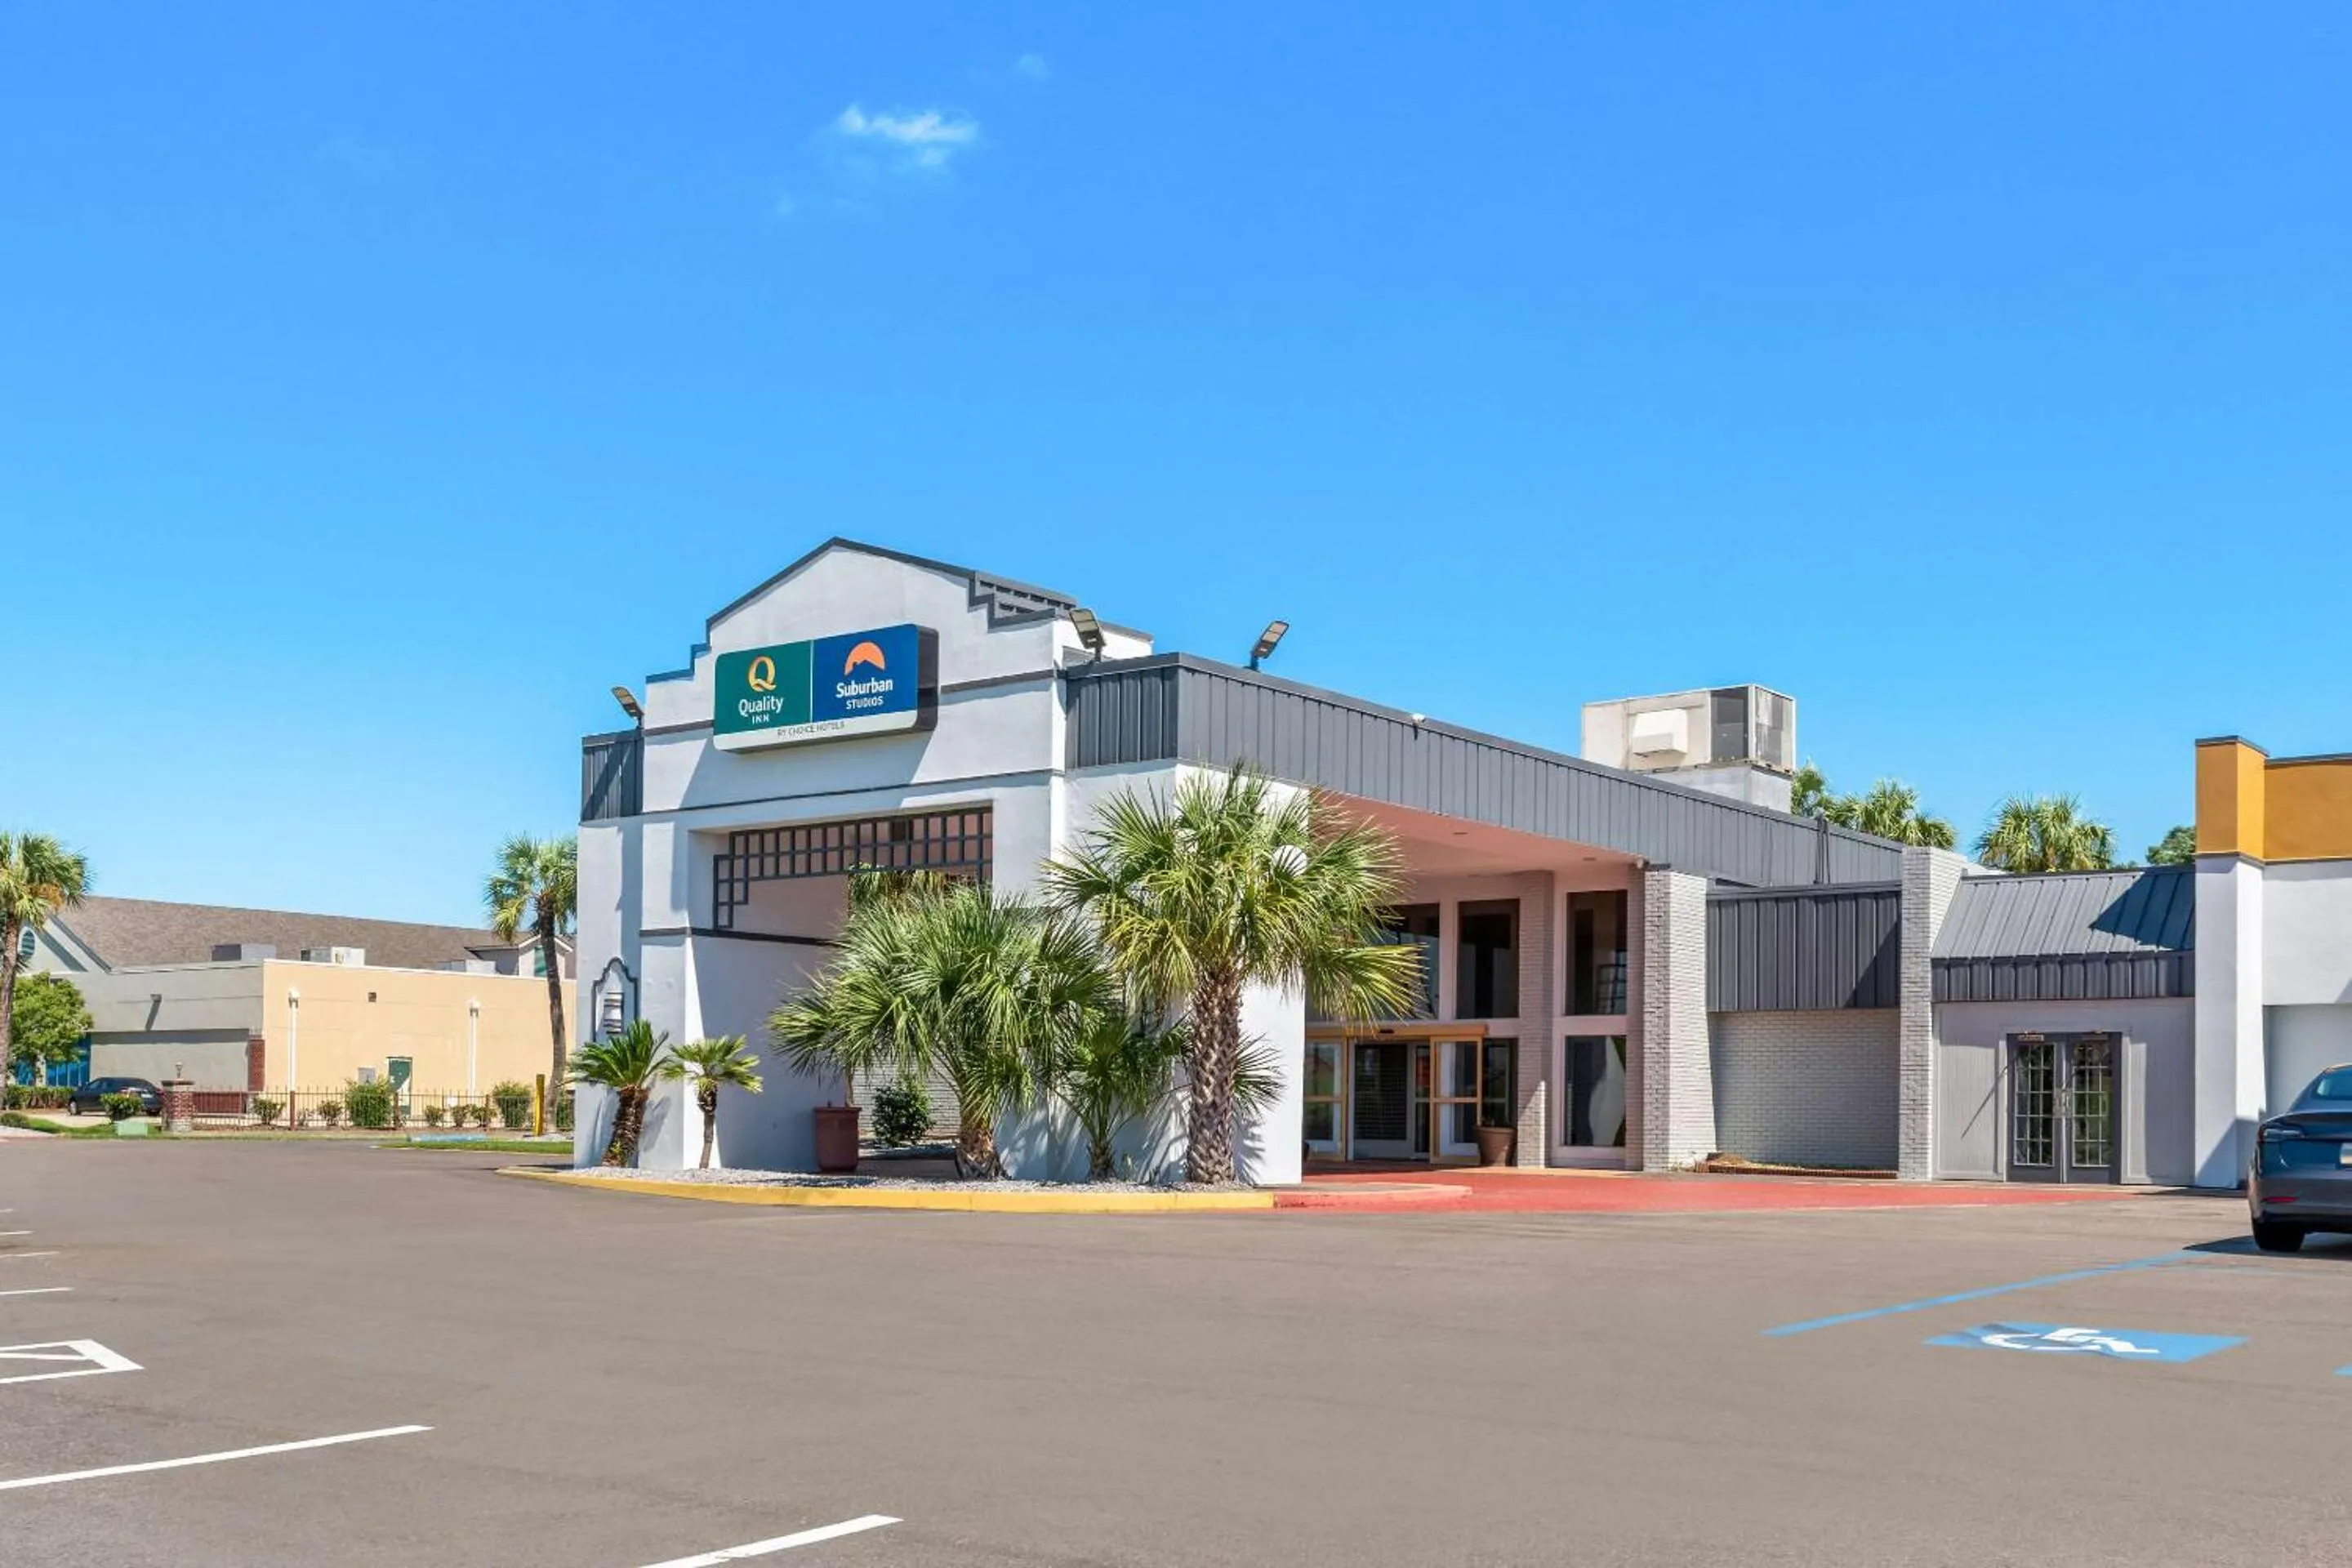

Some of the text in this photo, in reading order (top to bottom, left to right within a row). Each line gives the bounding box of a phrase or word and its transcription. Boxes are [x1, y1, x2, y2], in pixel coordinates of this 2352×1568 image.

[836, 678, 893, 698] Suburban
[738, 696, 784, 716] Quality
[846, 697, 884, 710] STUDIOS
[752, 714, 769, 724] INN
[788, 724, 816, 736] CHOICE
[816, 721, 844, 733] HOTELS
